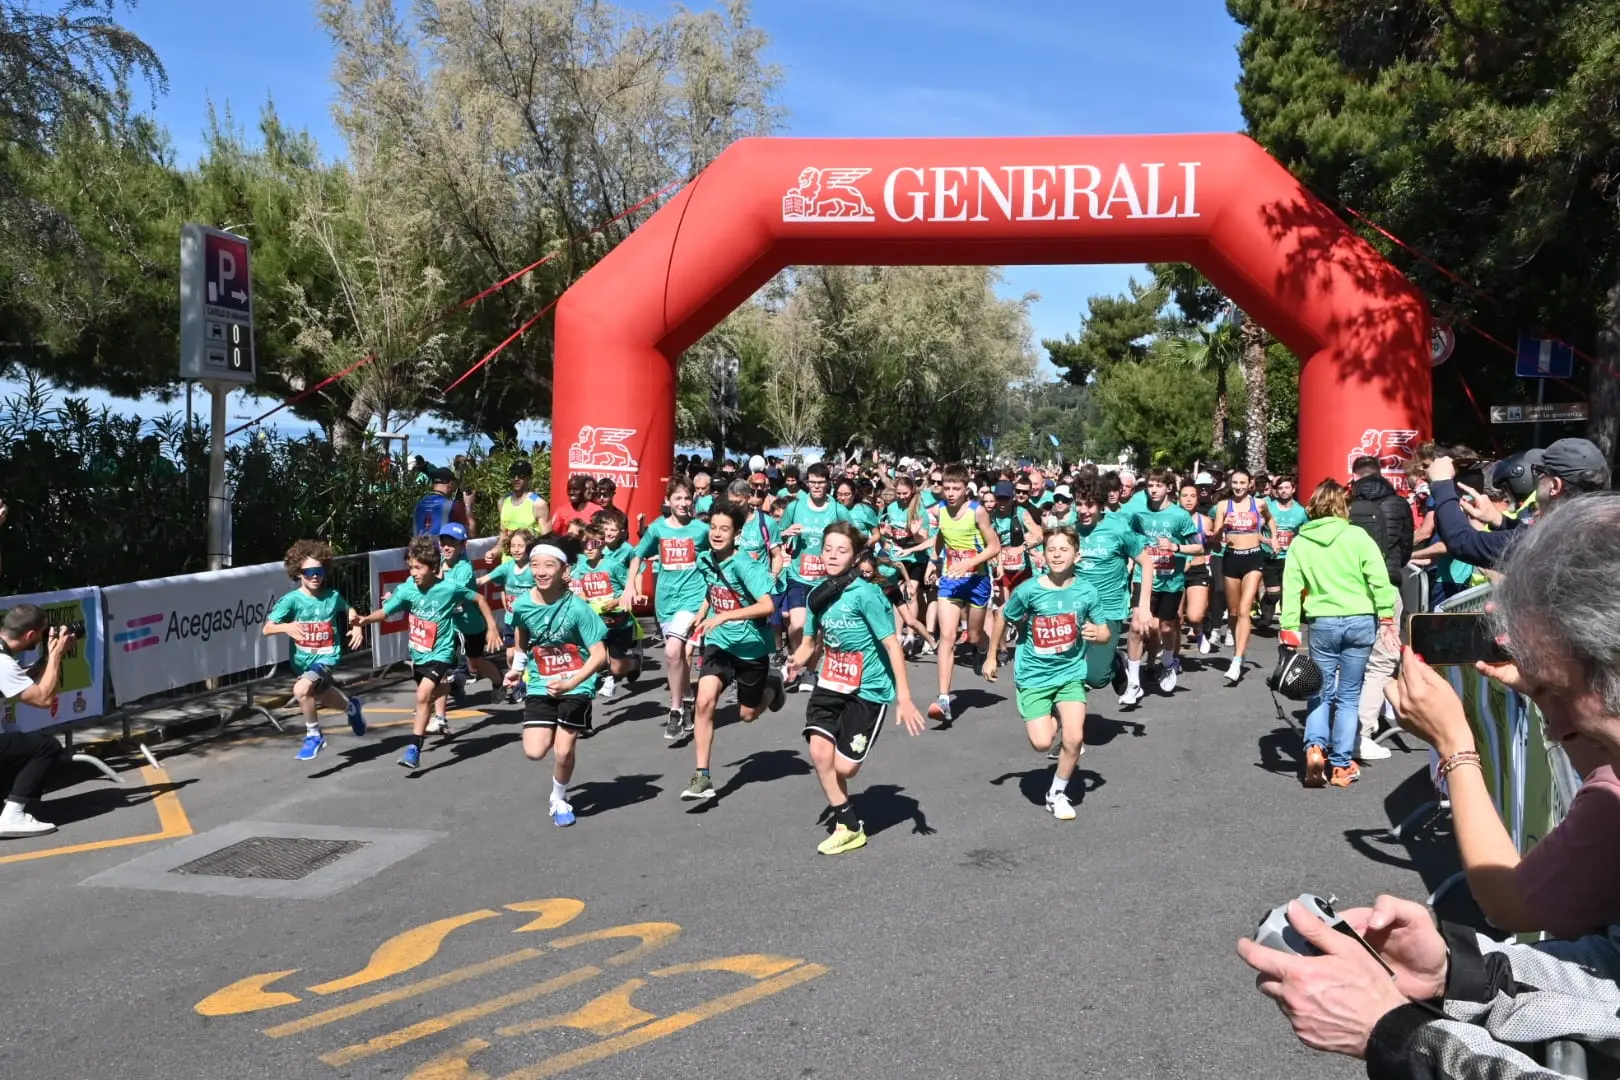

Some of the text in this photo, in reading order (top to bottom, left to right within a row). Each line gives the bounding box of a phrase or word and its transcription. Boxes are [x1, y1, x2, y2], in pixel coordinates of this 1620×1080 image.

[883, 162, 1201, 222] GENERALI
[218, 249, 236, 296] P
[1035, 623, 1073, 639] T2168
